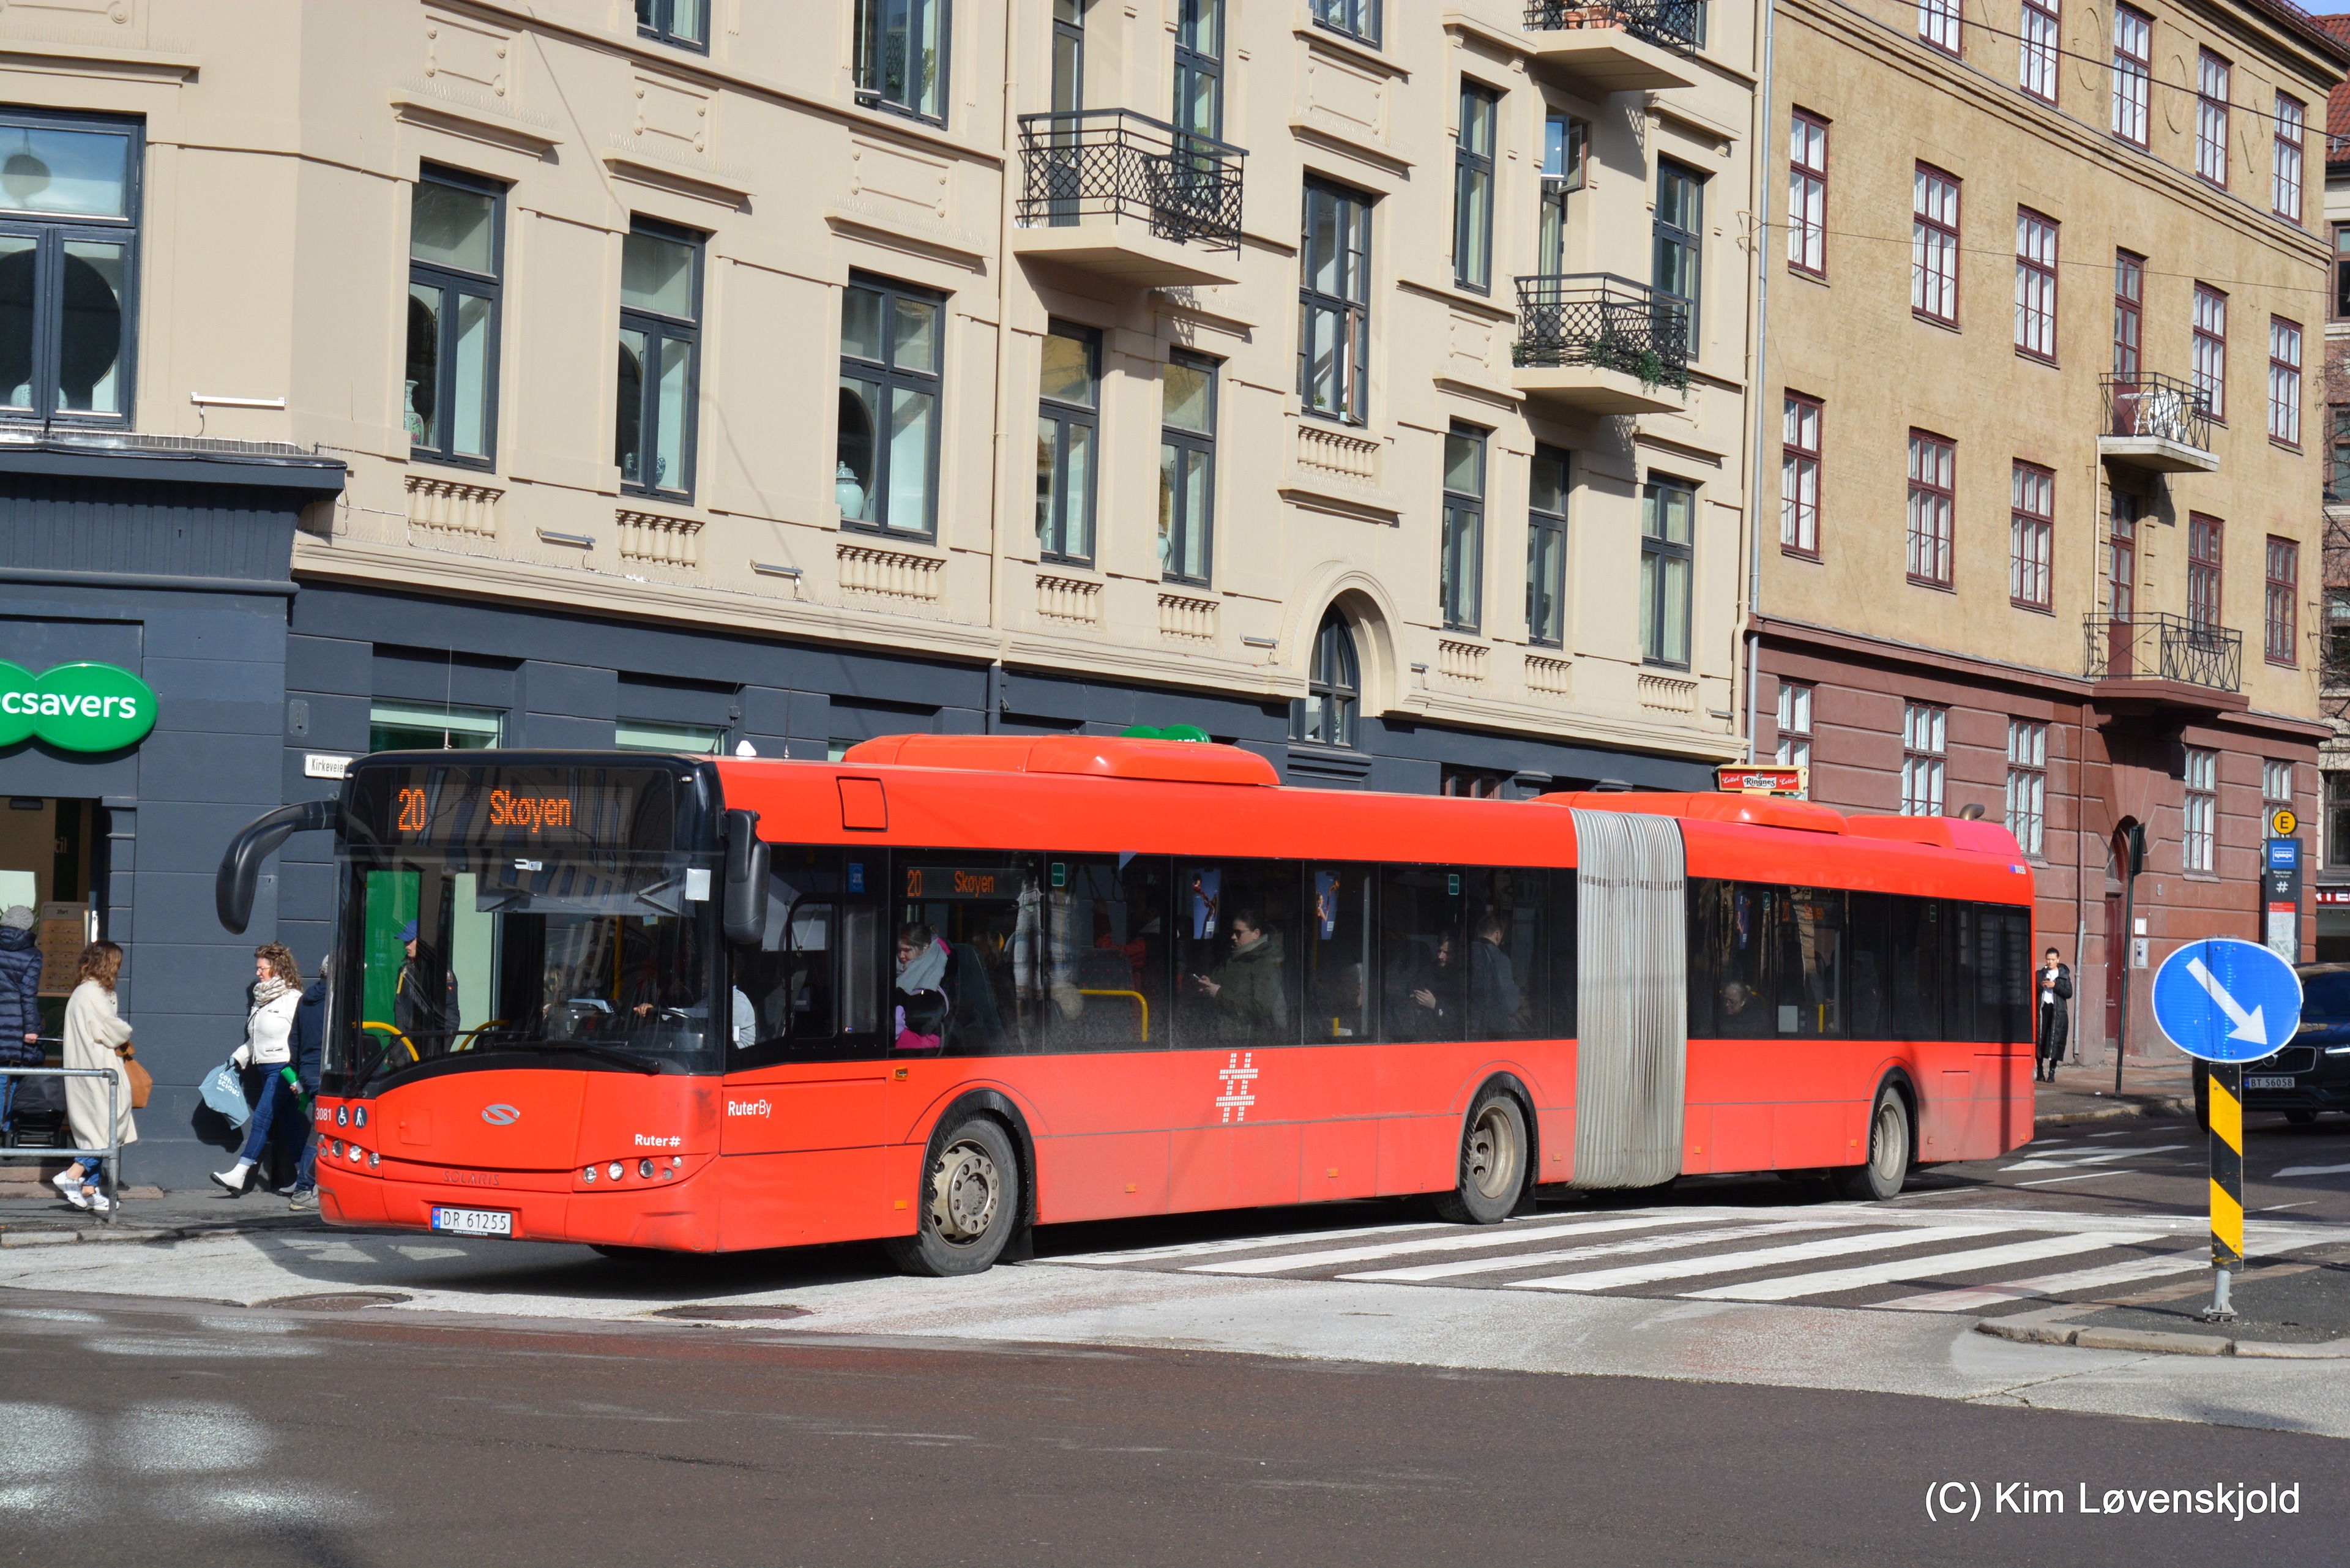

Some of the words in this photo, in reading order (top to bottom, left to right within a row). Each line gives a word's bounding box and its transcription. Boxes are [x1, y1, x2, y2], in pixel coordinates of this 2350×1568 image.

[0, 692, 136, 719] csavers
[1744, 777, 1775, 787] Ringnes
[398, 788, 425, 831] 20
[490, 790, 570, 833] Skøyen
[2280, 815, 2289, 829] E
[908, 869, 922, 897] 20
[2251, 1078, 2261, 1087] BT
[2266, 1078, 2292, 1087] 56058
[315, 1107, 332, 1121] 3081
[728, 1099, 772, 1118] RuterBy
[443, 1171, 499, 1186] SOLARIS
[444, 1211, 460, 1227] DR
[467, 1213, 506, 1230] 61255
